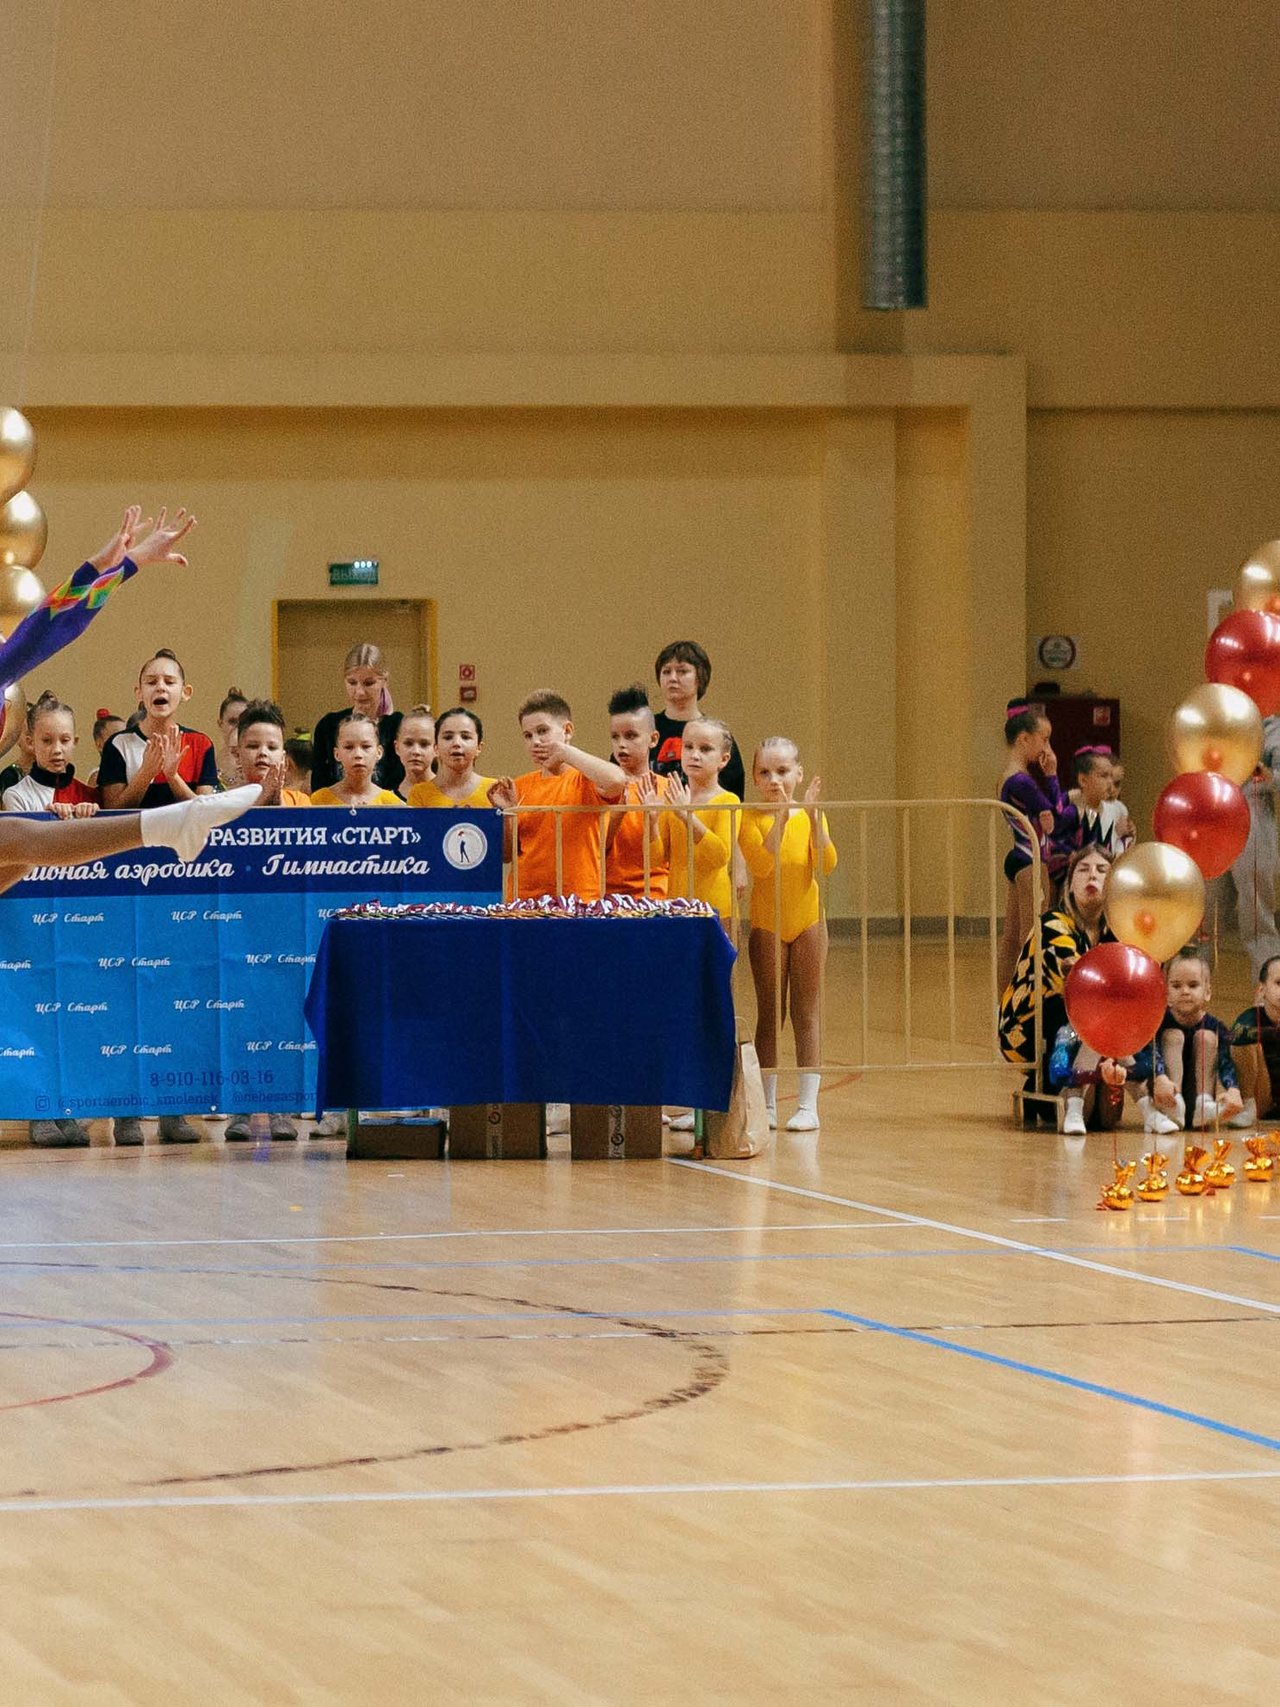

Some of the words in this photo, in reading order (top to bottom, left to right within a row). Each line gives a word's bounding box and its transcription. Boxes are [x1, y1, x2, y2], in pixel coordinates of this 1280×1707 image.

[209, 827, 328, 846] РАЗВИТИЯ
[331, 826, 422, 845] «СТАРТ»
[23, 860, 110, 882] ивная
[114, 857, 235, 887] аэробика
[262, 853, 431, 876] Гимнастика
[63, 912, 104, 926] Старт
[203, 910, 242, 923] Старт
[317, 908, 337, 921] ЦС
[131, 957, 170, 970] Старт
[277, 954, 317, 967] Старт
[67, 1002, 108, 1015] Старт
[206, 999, 245, 1012] Старт
[133, 1044, 172, 1057] Старт
[278, 1040, 316, 1053] Старт
[149, 1069, 274, 1087] 8-910-116-03-16
[232, 1089, 317, 1105] @nebesaspor
